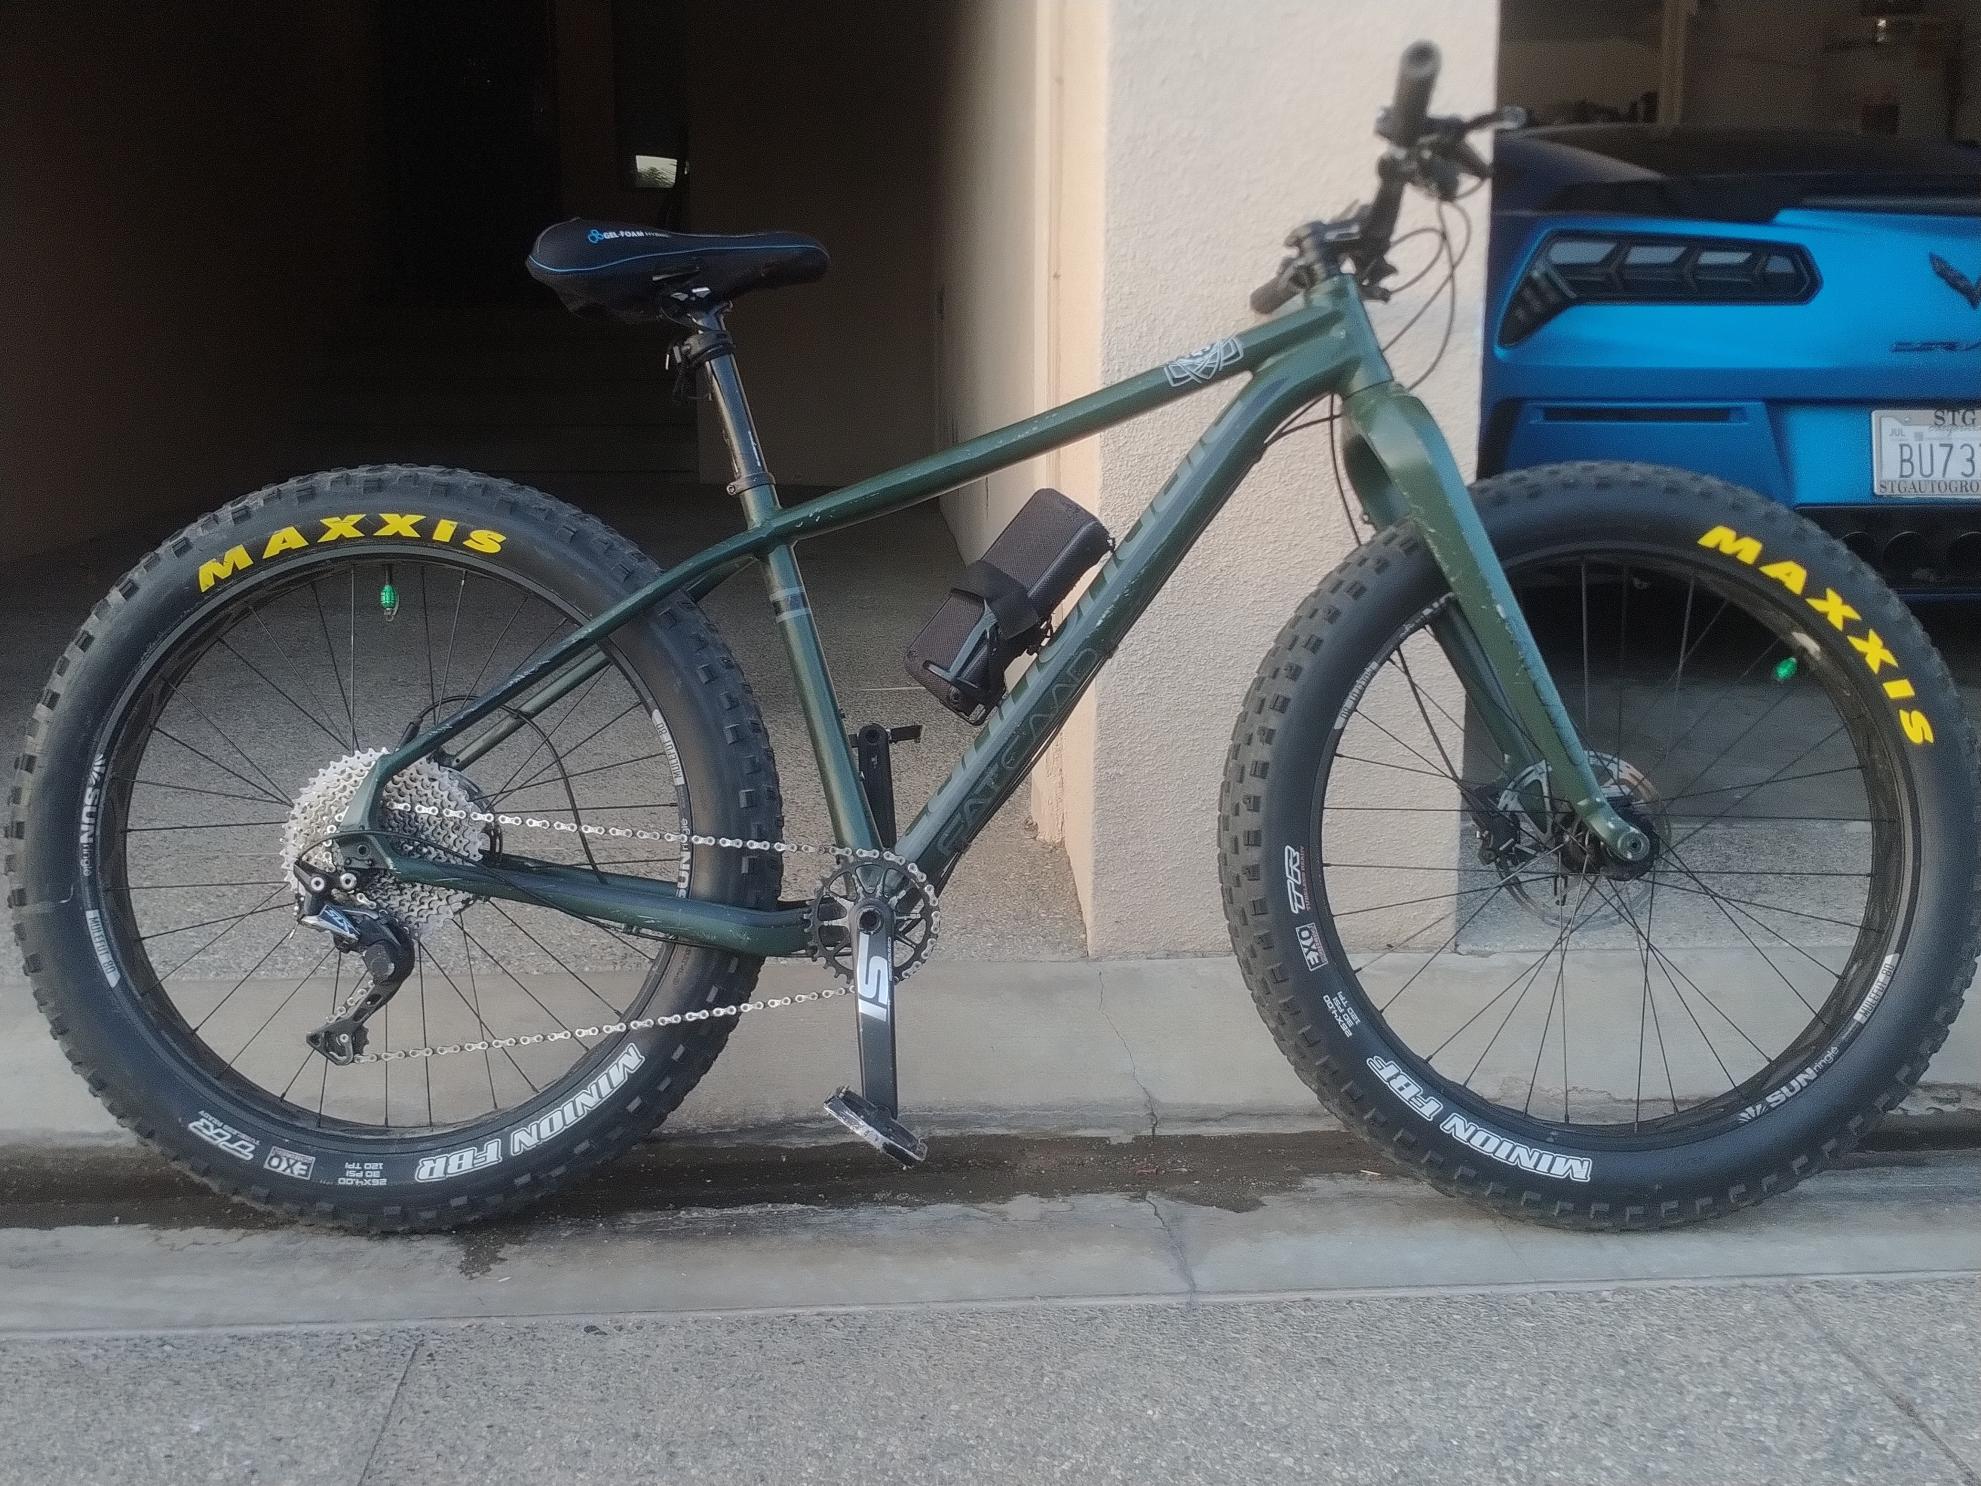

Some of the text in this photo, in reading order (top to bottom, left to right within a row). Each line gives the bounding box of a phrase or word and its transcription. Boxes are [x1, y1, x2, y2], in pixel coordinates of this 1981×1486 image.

[1898, 443, 1981, 479] BU73
[198, 513, 507, 593] MAXXIS
[1697, 525, 1934, 745] MAXXIS
[80, 787, 100, 844] SUN
[1298, 926, 1321, 967] EXO
[1332, 996, 1344, 1013] PSI
[1347, 1007, 1361, 1025] 120
[1765, 1067, 1818, 1108] SUN
[415, 1043, 645, 1182] MINION FBR
[1367, 1056, 1592, 1182] MINION FBF
[267, 1154, 309, 1177] EXO
